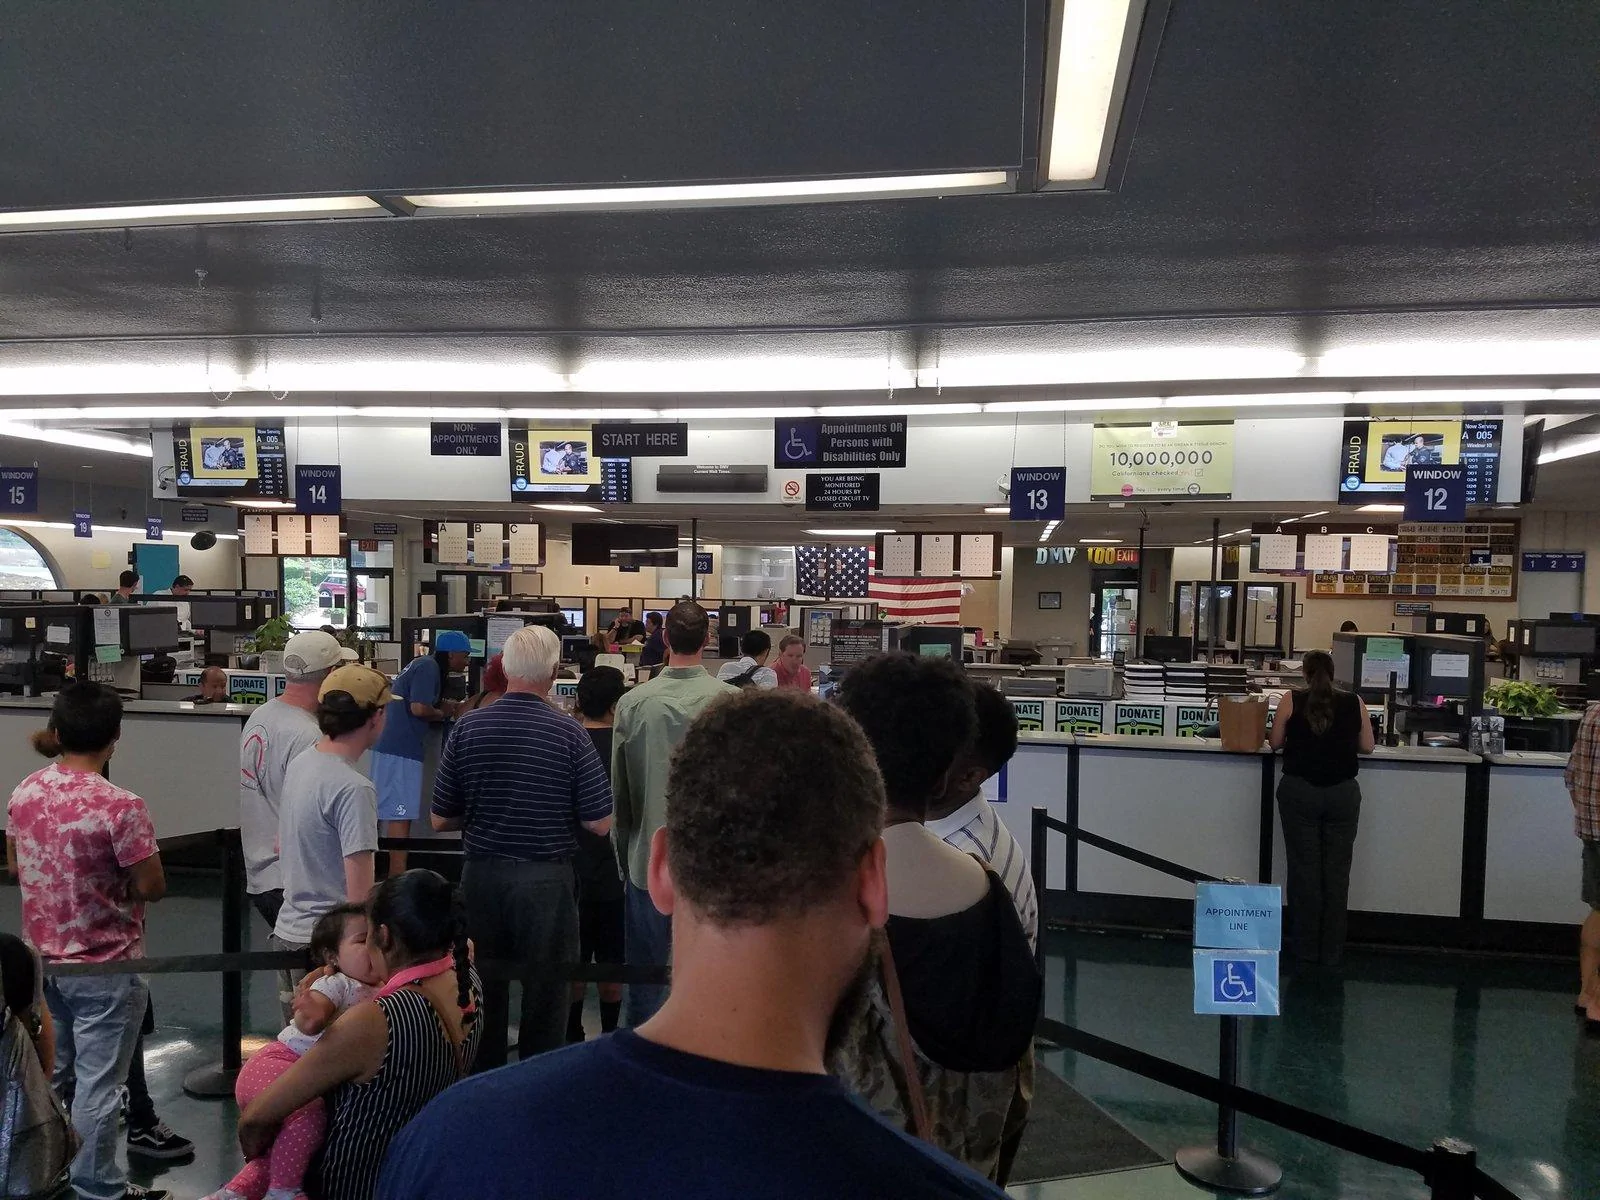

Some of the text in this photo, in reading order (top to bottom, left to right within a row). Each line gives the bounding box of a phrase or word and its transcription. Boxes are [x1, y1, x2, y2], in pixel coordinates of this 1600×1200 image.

[453, 423, 477, 432] NON-
[821, 422, 903, 435] Appointments OR
[257, 435, 279, 443] A 005
[432, 434, 499, 444] APPOINTMENTS
[602, 432, 678, 446] START HERE
[1461, 431, 1493, 440] A 005
[830, 437, 893, 448] Persons with
[178, 439, 189, 472] FRAUD
[455, 446, 478, 455] ONLY
[1347, 435, 1362, 474] FRAUD
[514, 442, 526, 477] FRAUD
[822, 450, 901, 462] Disabilities Only
[1110, 450, 1213, 469] 10,000,000
[1, 471, 33, 480] WINDOW
[300, 469, 336, 478] WINDOW
[1016, 472, 1061, 481] WINDOW
[1413, 470, 1462, 479] WINDOW
[9, 486, 25, 505] 15
[309, 485, 327, 504] 14
[1027, 489, 1048, 510] 13
[1424, 488, 1448, 510] 12
[80, 522, 88, 533] 19
[150, 526, 160, 536] 20
[439, 523, 447, 532] A
[474, 524, 482, 533] B
[510, 525, 518, 533] C
[1275, 525, 1283, 533] A
[1366, 526, 1374, 534] C
[361, 541, 377, 549] EXIT
[1036, 547, 1077, 565] DMV
[1117, 550, 1135, 561] EXIT
[697, 561, 708, 571] 23
[1530, 560, 1535, 568] 1
[1551, 560, 1557, 569] 2
[1571, 560, 1577, 569] 3
[232, 678, 265, 689] DONATE
[1015, 704, 1040, 715] NATE
[1060, 705, 1100, 717] DONATE
[1119, 708, 1161, 719] DONATE
[1205, 907, 1273, 918] APPOINTMENT
[1229, 922, 1249, 931] LINE
